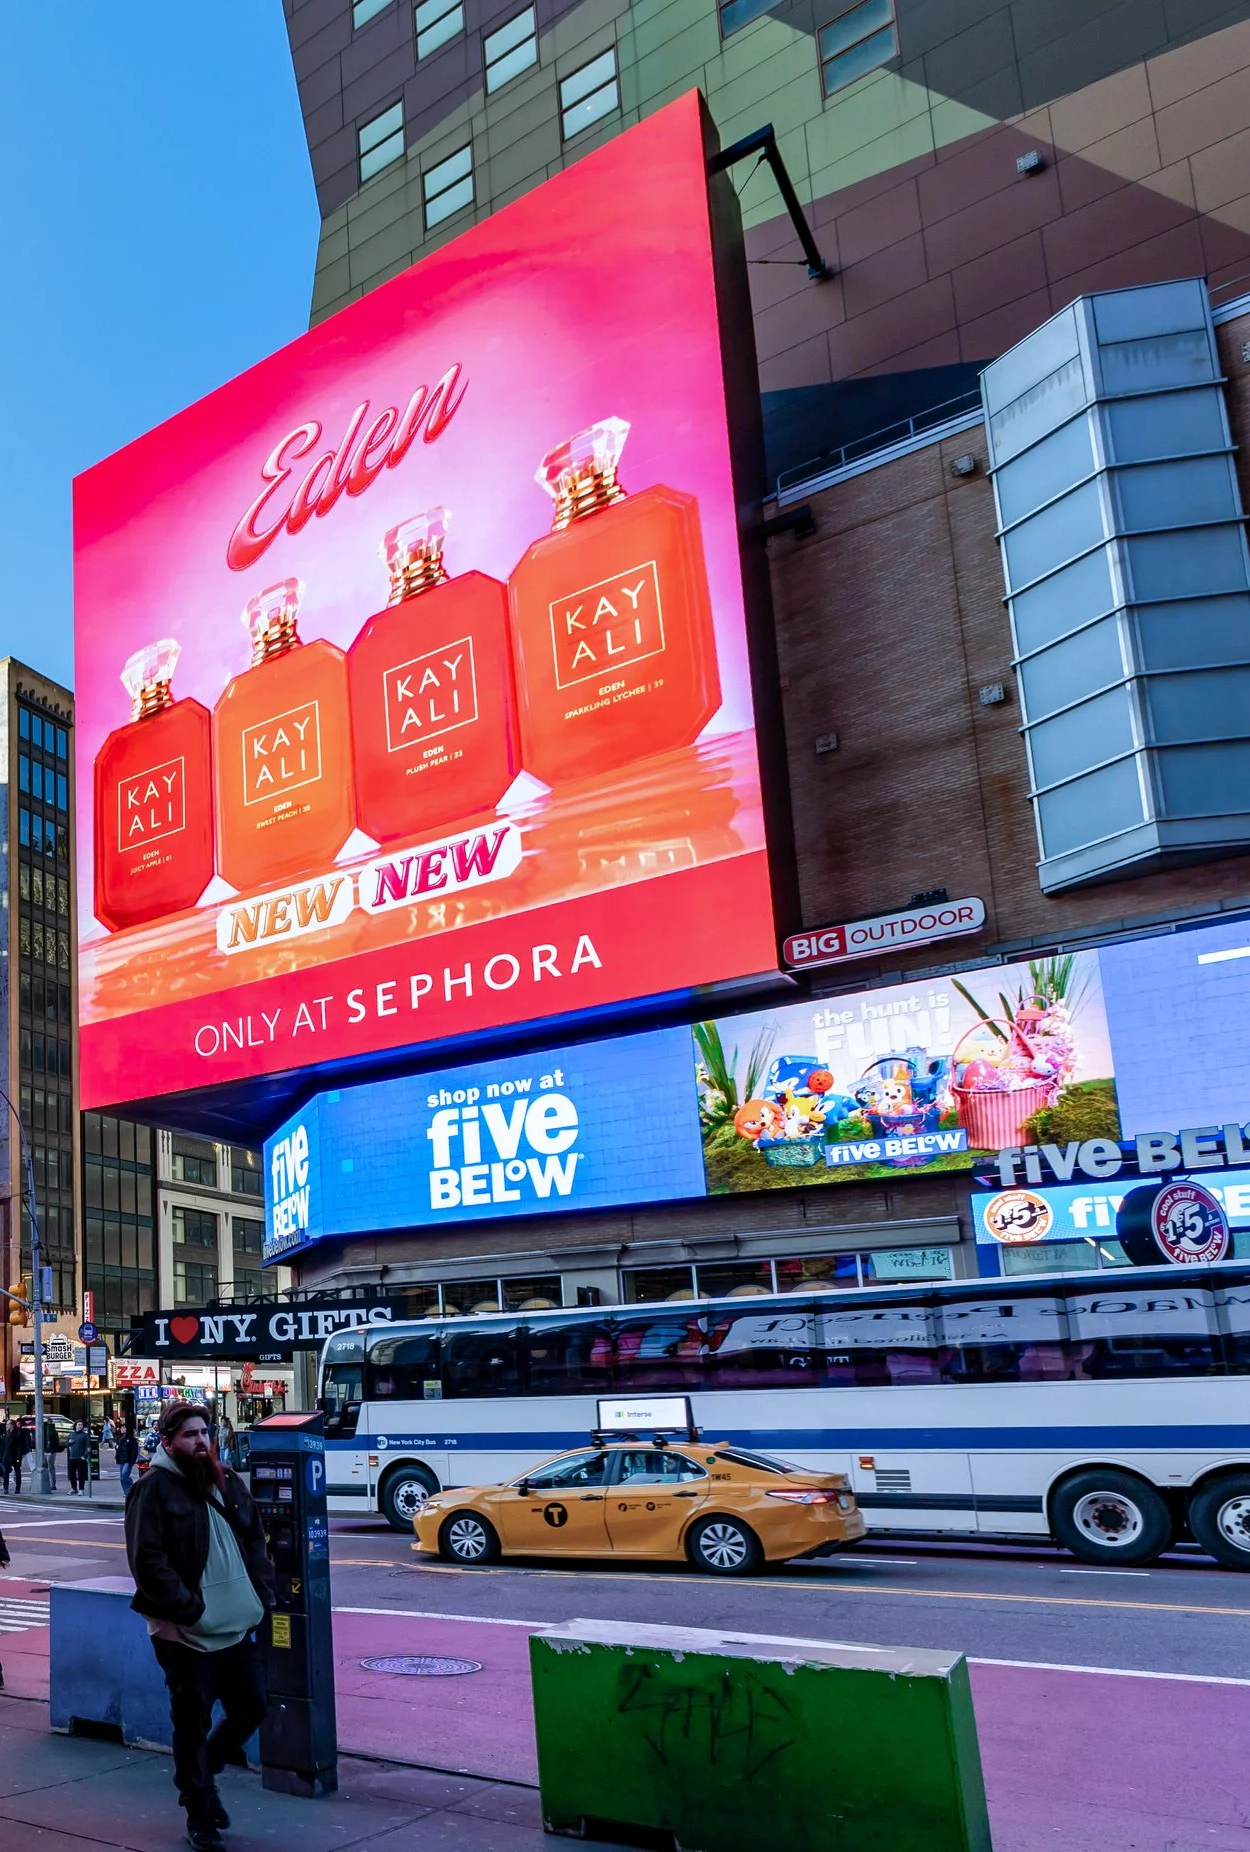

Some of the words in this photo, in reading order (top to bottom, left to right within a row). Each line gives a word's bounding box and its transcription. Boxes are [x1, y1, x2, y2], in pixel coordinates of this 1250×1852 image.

[225, 361, 470, 572] Eden
[566, 580, 645, 635] KAY
[571, 618, 642, 669] ALI
[397, 654, 462, 702] KAY
[598, 680, 625, 696] EDEN
[400, 689, 459, 734] ALI
[564, 698, 611, 720] SPARKLING
[613, 686, 646, 703] LYCHEE
[254, 716, 310, 759] KAY
[423, 745, 444, 759] EDEN
[256, 749, 305, 788] ALI
[406, 763, 429, 775] PLUSH
[430, 755, 448, 767] PEAR
[128, 771, 177, 810] KAY
[274, 800, 292, 813] EDEN
[128, 801, 172, 837] ALI
[142, 849, 160, 861] EDEN
[227, 878, 345, 948] NEW
[371, 825, 510, 907] NEW
[792, 932, 840, 960] BIG
[850, 906, 974, 944] OUTDOOR
[194, 1008, 281, 1057] ONLY
[292, 996, 333, 1037] AT
[347, 935, 602, 1023] SEPHORA
[812, 1008, 855, 1029] the
[861, 995, 921, 1021] hunt
[928, 990, 949, 1008] is
[814, 1008, 953, 1062] FUN!
[426, 1088, 480, 1108] shop
[487, 1078, 532, 1096] now
[538, 1069, 565, 1089] at
[426, 1094, 579, 1169] five
[830, 1142, 881, 1163] five
[885, 1132, 962, 1157] BELOW
[272, 1125, 309, 1203] five
[430, 1152, 579, 1210] BELOW
[994, 1138, 1123, 1186] five
[1069, 1195, 1123, 1229] fi
[1160, 1195, 1174, 1216] cool
[1173, 1190, 1196, 1200] stuff
[1174, 1248, 1198, 1263] five
[155, 1319, 169, 1346] I
[269, 1307, 392, 1341] GIFTS
[46, 1352, 72, 1360] BURGER
[337, 1342, 355, 1351] 2718
[312, 1461, 323, 1490] P
[549, 1507, 562, 1525] T
